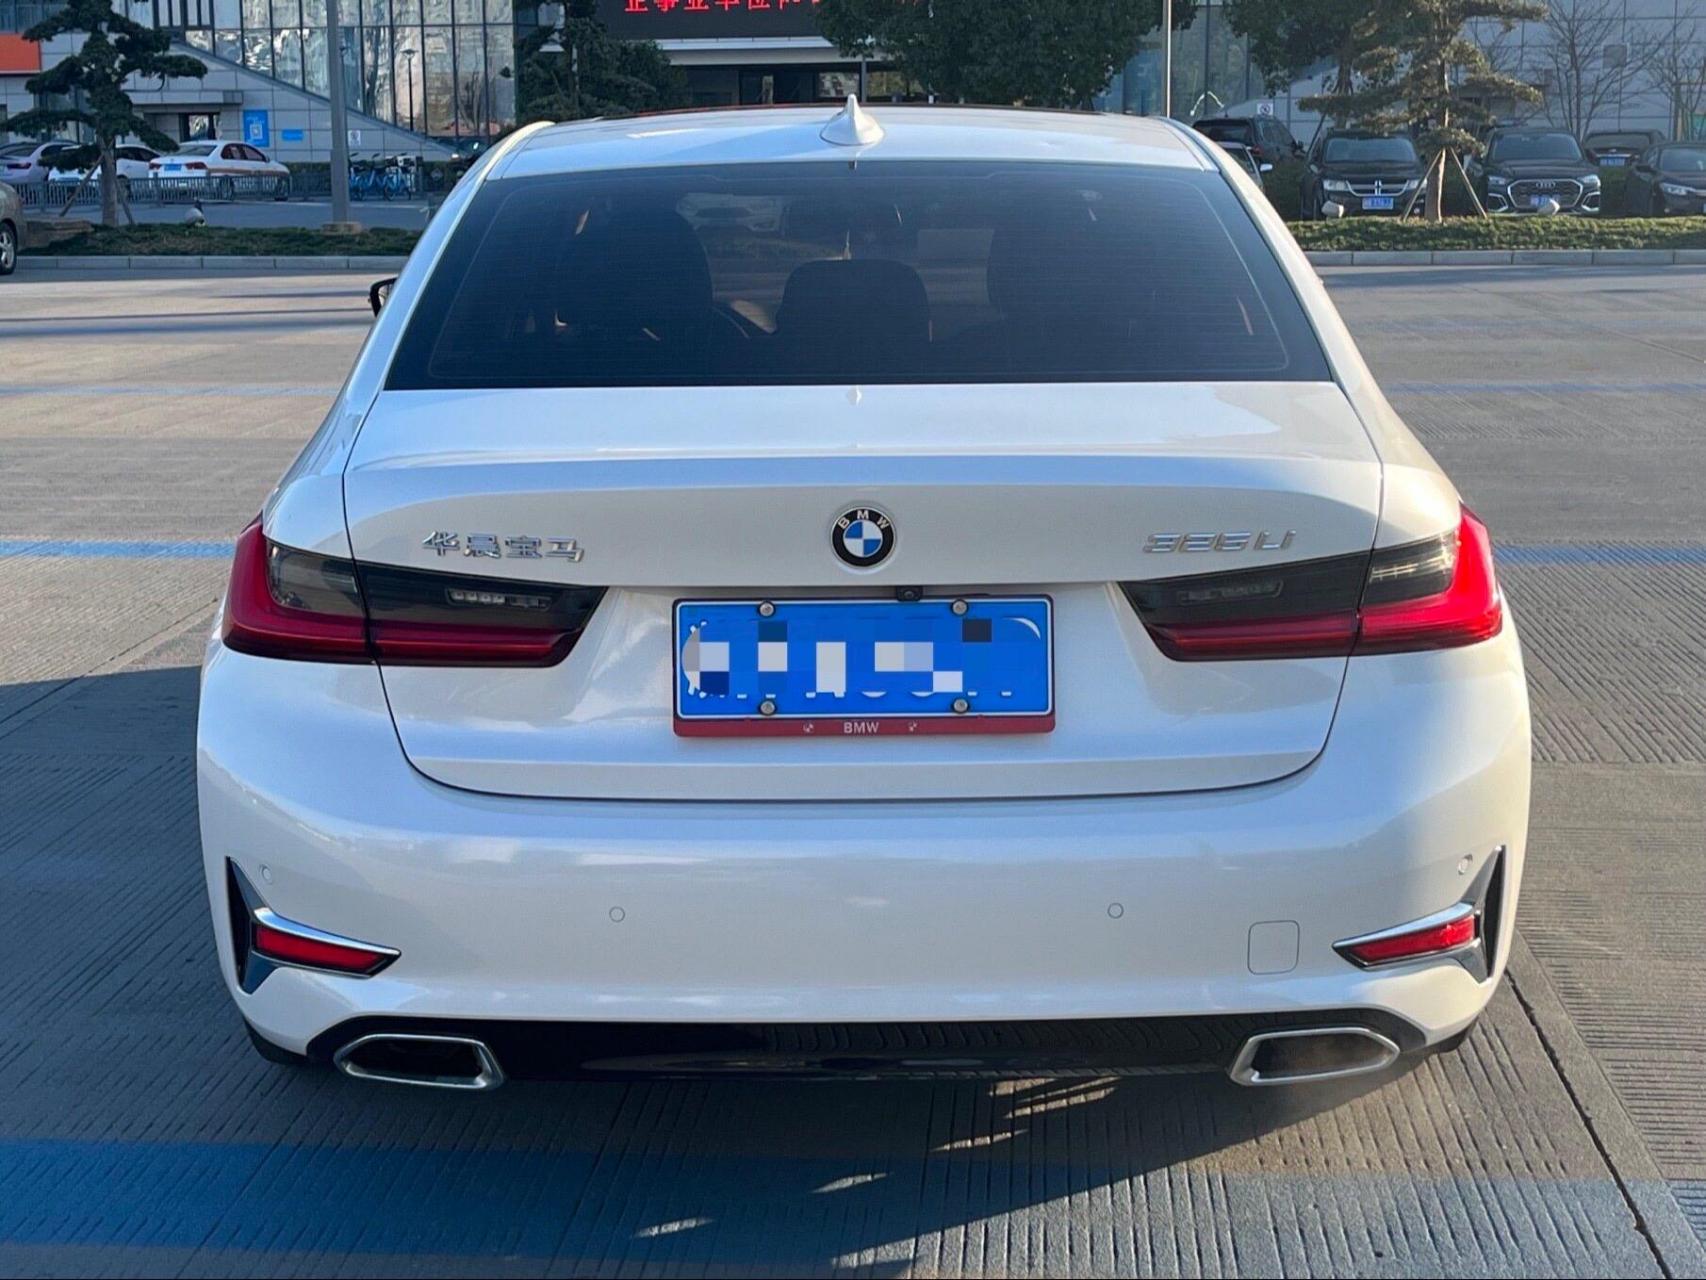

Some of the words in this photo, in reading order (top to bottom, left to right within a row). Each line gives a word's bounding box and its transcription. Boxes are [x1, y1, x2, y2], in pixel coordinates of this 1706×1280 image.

[838, 509, 890, 529] BMW
[422, 531, 585, 563] 华晨宝马
[843, 721, 879, 734] BMW
